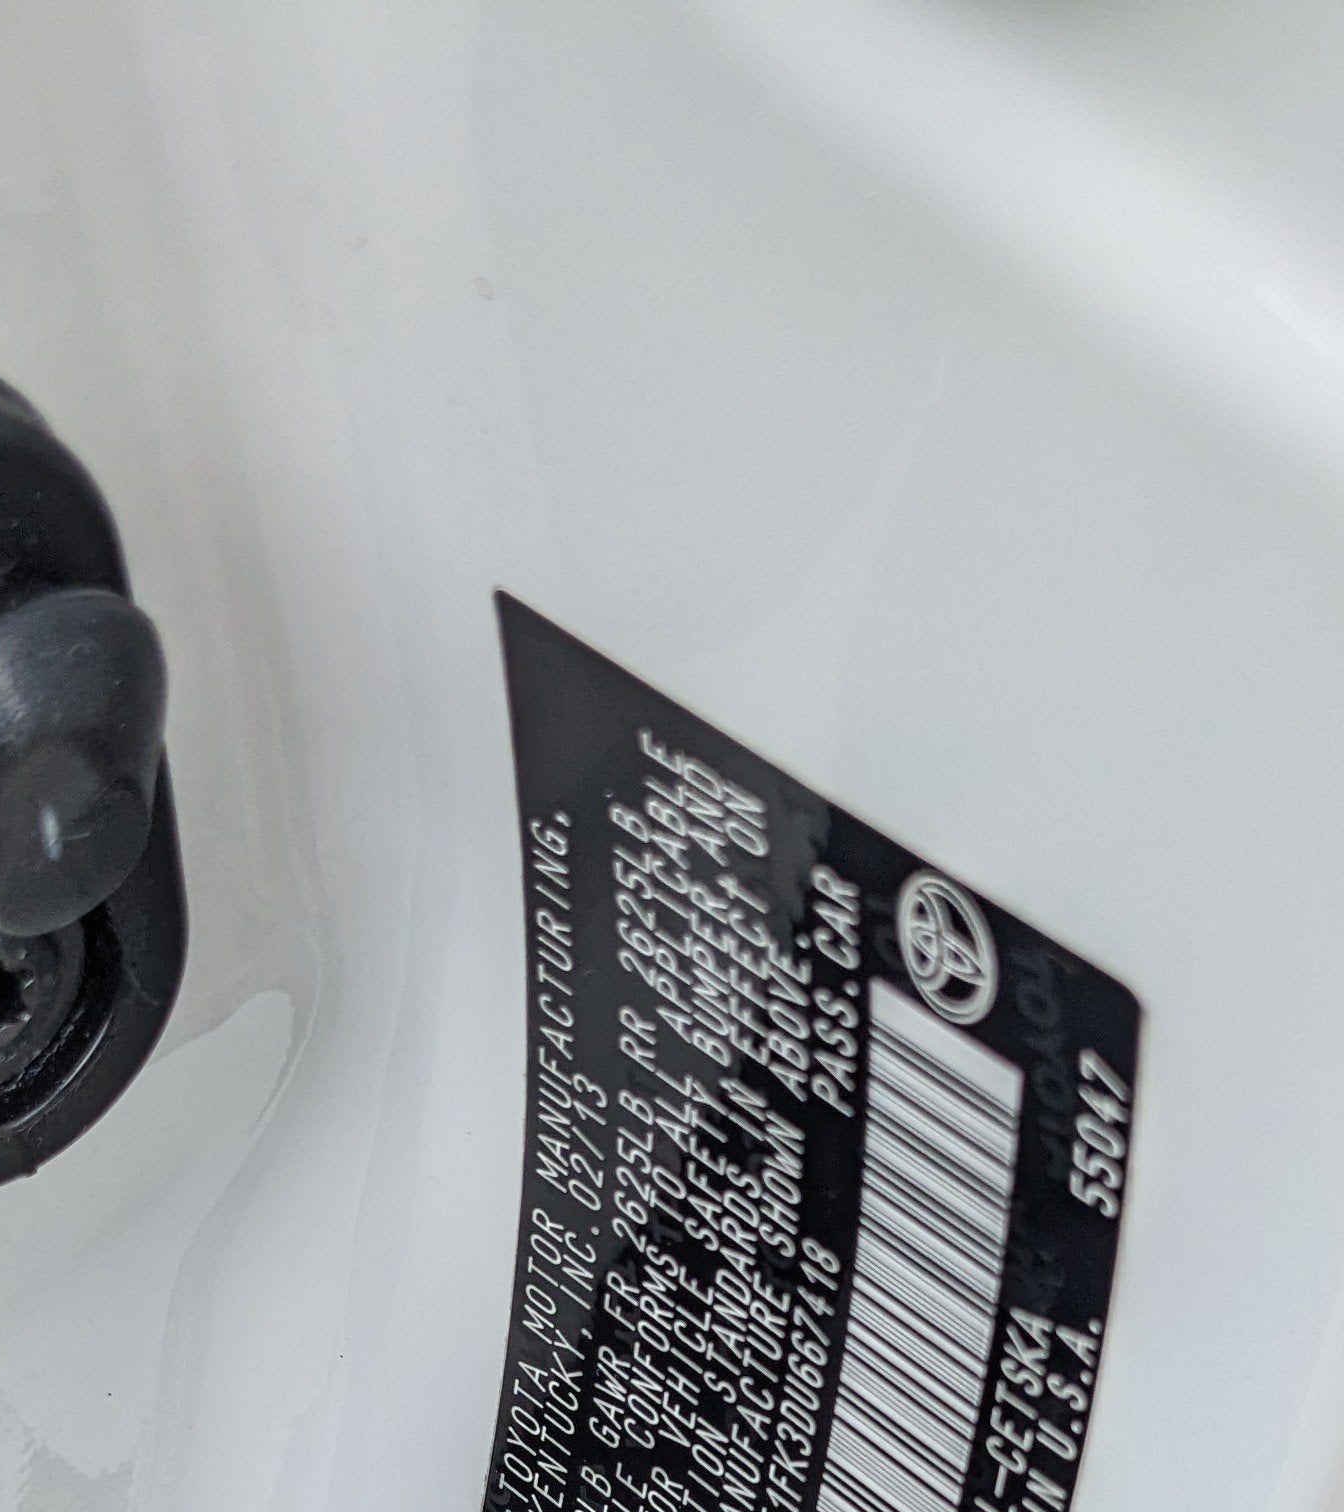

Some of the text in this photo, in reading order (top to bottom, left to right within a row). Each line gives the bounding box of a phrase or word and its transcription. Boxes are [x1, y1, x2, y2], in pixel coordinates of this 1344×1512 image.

[639, 727, 692, 1043] APPLICABLE
[725, 779, 768, 857] ON
[619, 1003, 658, 1072] RR
[729, 873, 769, 1065] EFFECT
[767, 931, 812, 1103] ABOVE.
[610, 1088, 657, 1252] 2625LB
[655, 1068, 691, 1151] ALL
[657, 1264, 714, 1446] VEHICLE
[686, 754, 728, 866] AND
[729, 1078, 767, 1141] IN
[1066, 1045, 1131, 1219] 55047
[650, 1162, 689, 1222] TO
[757, 1109, 805, 1258] SHOWN
[522, 1206, 565, 1344] MOTOR
[603, 1268, 643, 1330] FR
[625, 1243, 681, 1449] CONFORMS
[702, 1161, 764, 1403] STANDARDS
[586, 1343, 632, 1448] GAWR
[1035, 1317, 1103, 1461] U.S.A.
